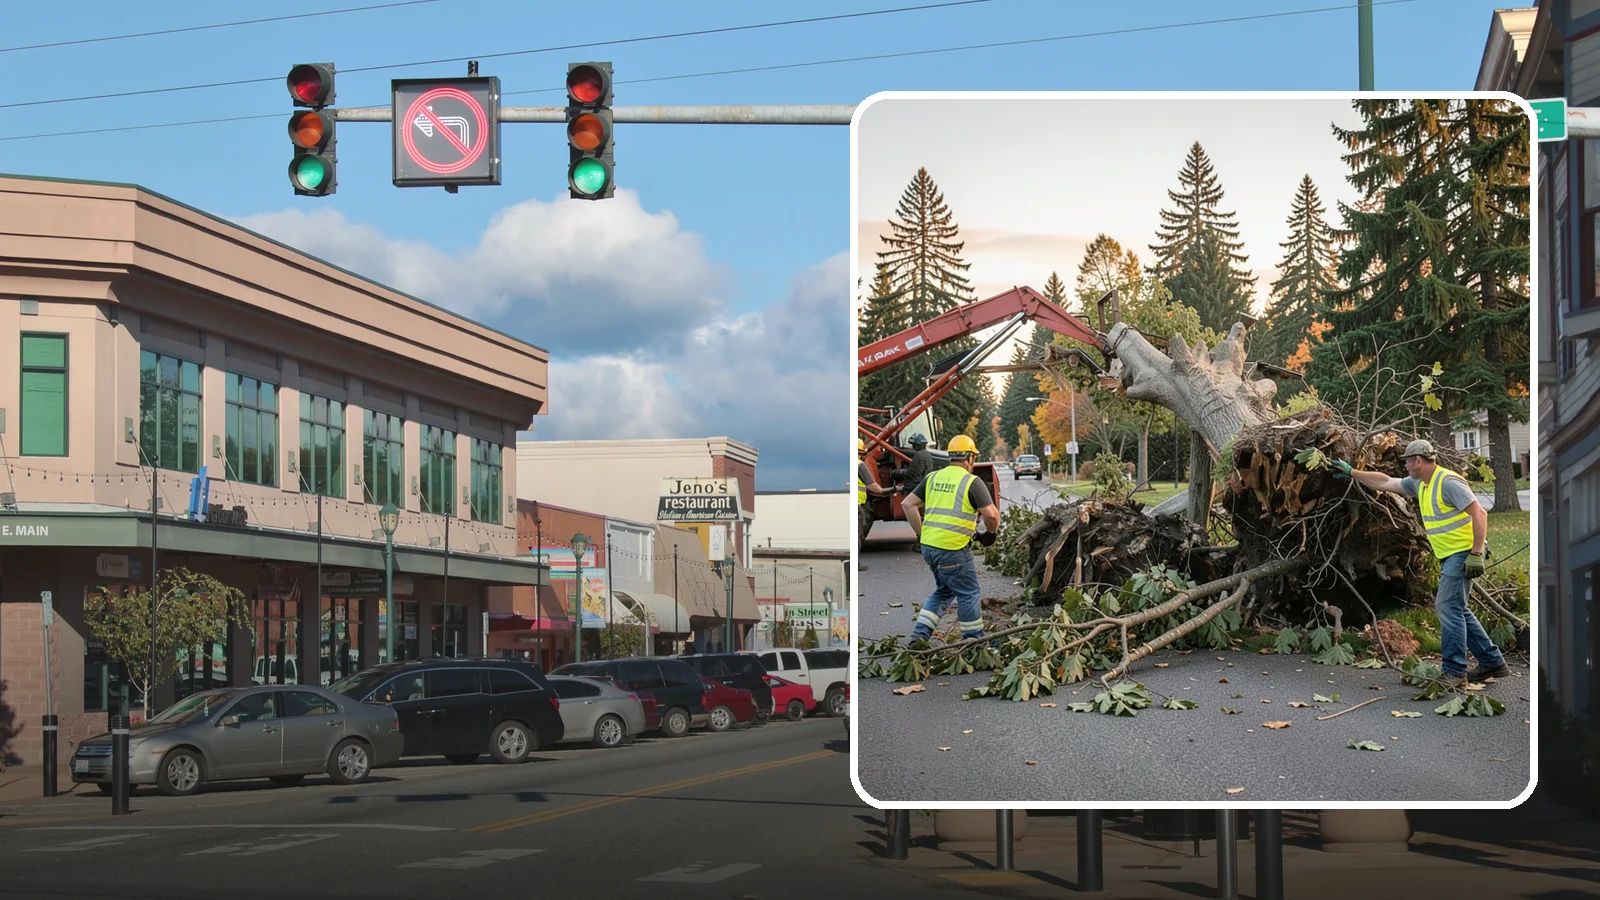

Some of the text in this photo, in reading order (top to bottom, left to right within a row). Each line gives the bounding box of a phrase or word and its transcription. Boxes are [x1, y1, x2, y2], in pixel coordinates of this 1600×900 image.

[670, 480, 728, 494] Jeno's
[665, 496, 731, 508] restaurant
[658, 510, 681, 520] Italian
[686, 510, 714, 519] American
[715, 509, 737, 519] Cuisine
[2, 525, 49, 536] E. MAIN
[797, 608, 828, 616] Street
[791, 619, 823, 627] lass
